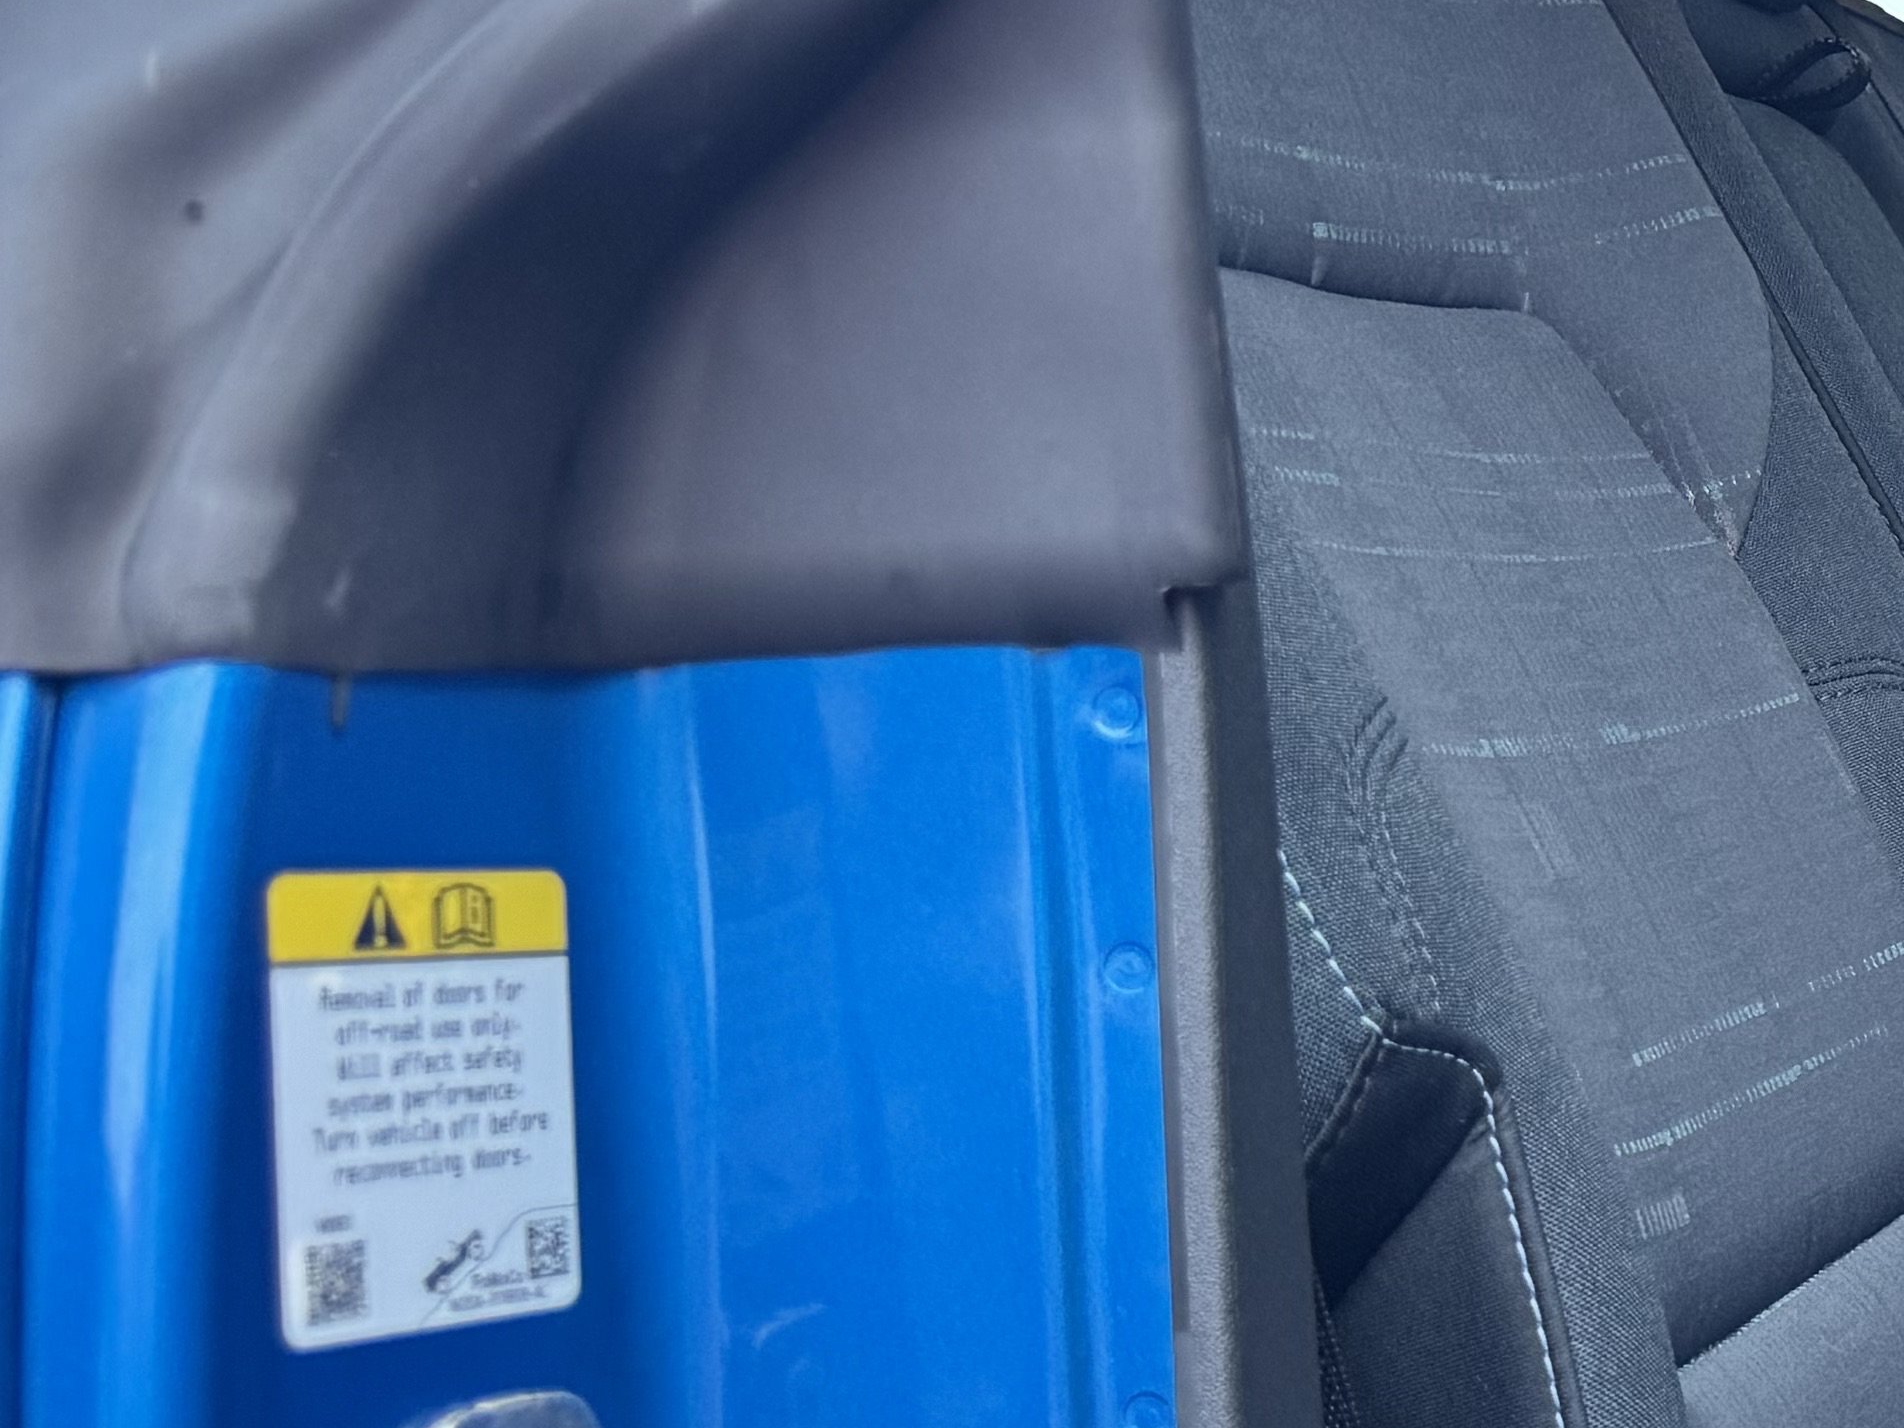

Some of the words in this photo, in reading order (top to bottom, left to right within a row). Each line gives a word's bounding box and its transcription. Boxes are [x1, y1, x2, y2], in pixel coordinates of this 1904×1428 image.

[320, 984, 396, 1009] Removal
[402, 980, 423, 1006] of
[432, 981, 486, 1005] doors
[494, 977, 525, 1003] for
[336, 1019, 422, 1044] off-road
[431, 1019, 462, 1039] use
[390, 1049, 454, 1077] affect
[462, 1044, 522, 1074] safety
[328, 1093, 393, 1119] system
[313, 1127, 359, 1153] Turn
[368, 1118, 441, 1146] vehicle
[449, 1111, 480, 1140] off
[488, 1108, 549, 1135] before
[335, 1153, 463, 1184] reconnecting
